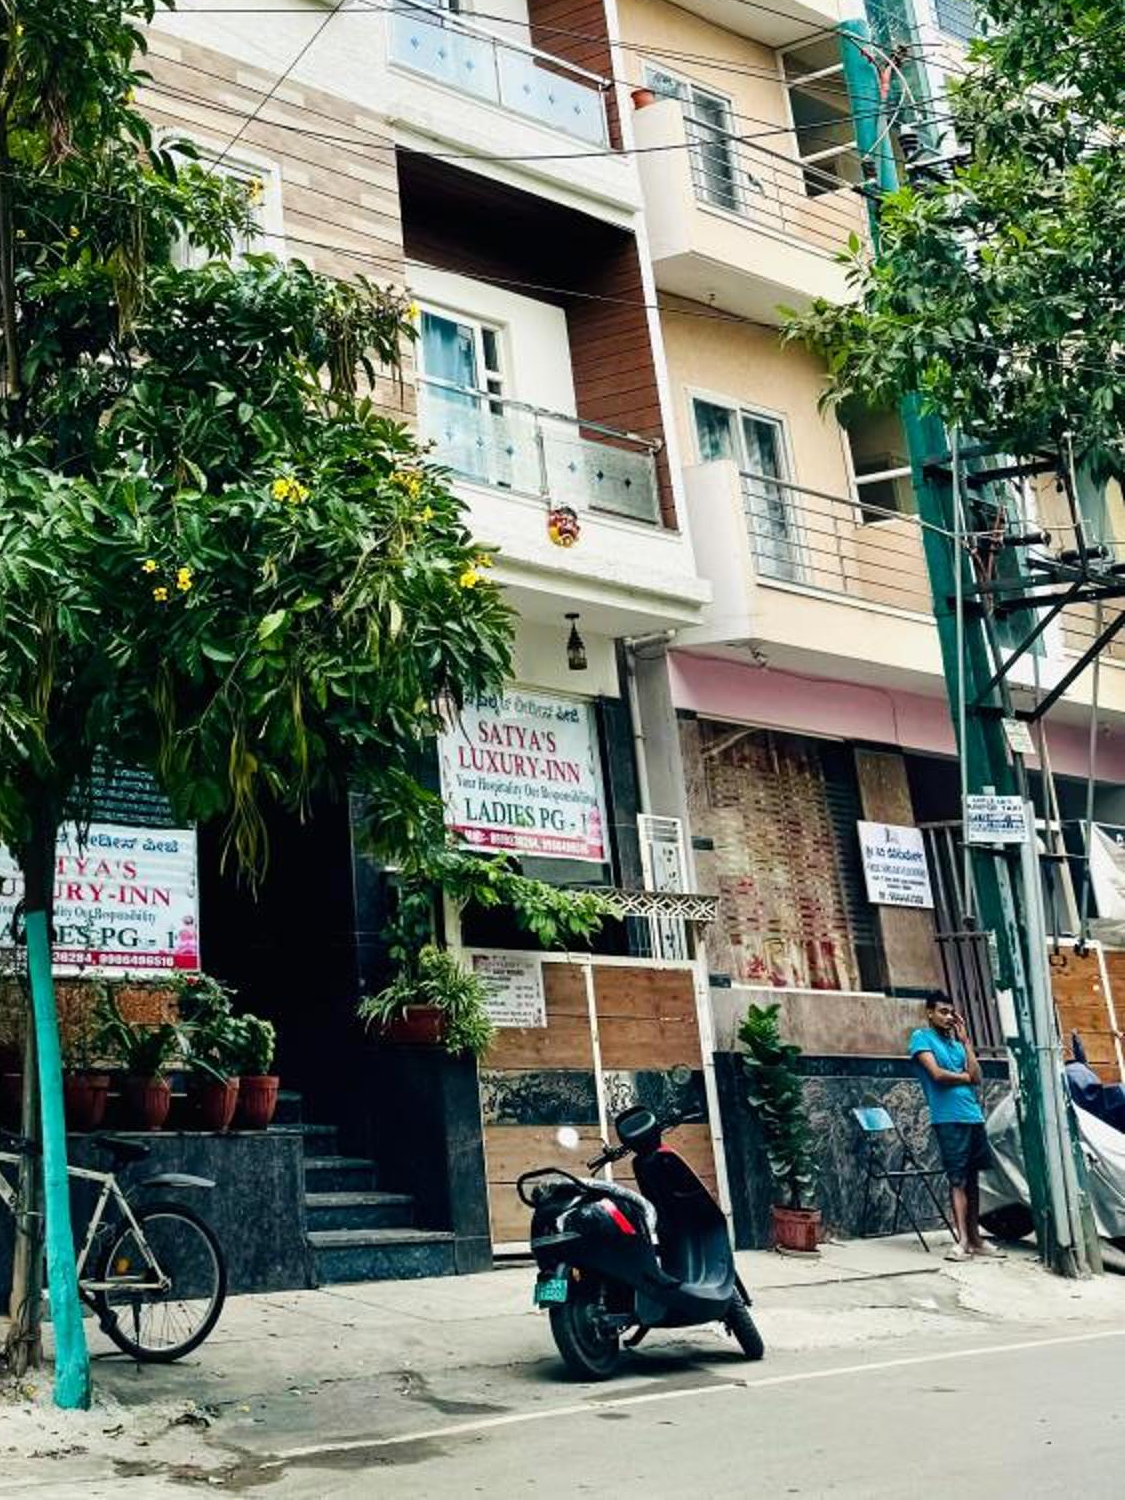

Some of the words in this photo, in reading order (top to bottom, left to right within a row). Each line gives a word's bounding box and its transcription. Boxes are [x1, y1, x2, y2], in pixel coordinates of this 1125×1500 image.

[478, 720, 556, 753] SATYA'S
[458, 745, 580, 785] LUXURY-INN
[456, 773, 476, 788] Your
[478, 776, 523, 800] Hospitality
[465, 797, 535, 827] LADIES
[539, 807, 565, 831] PG
[56, 855, 138, 881] TYA'S
[101, 927, 140, 949] PG
